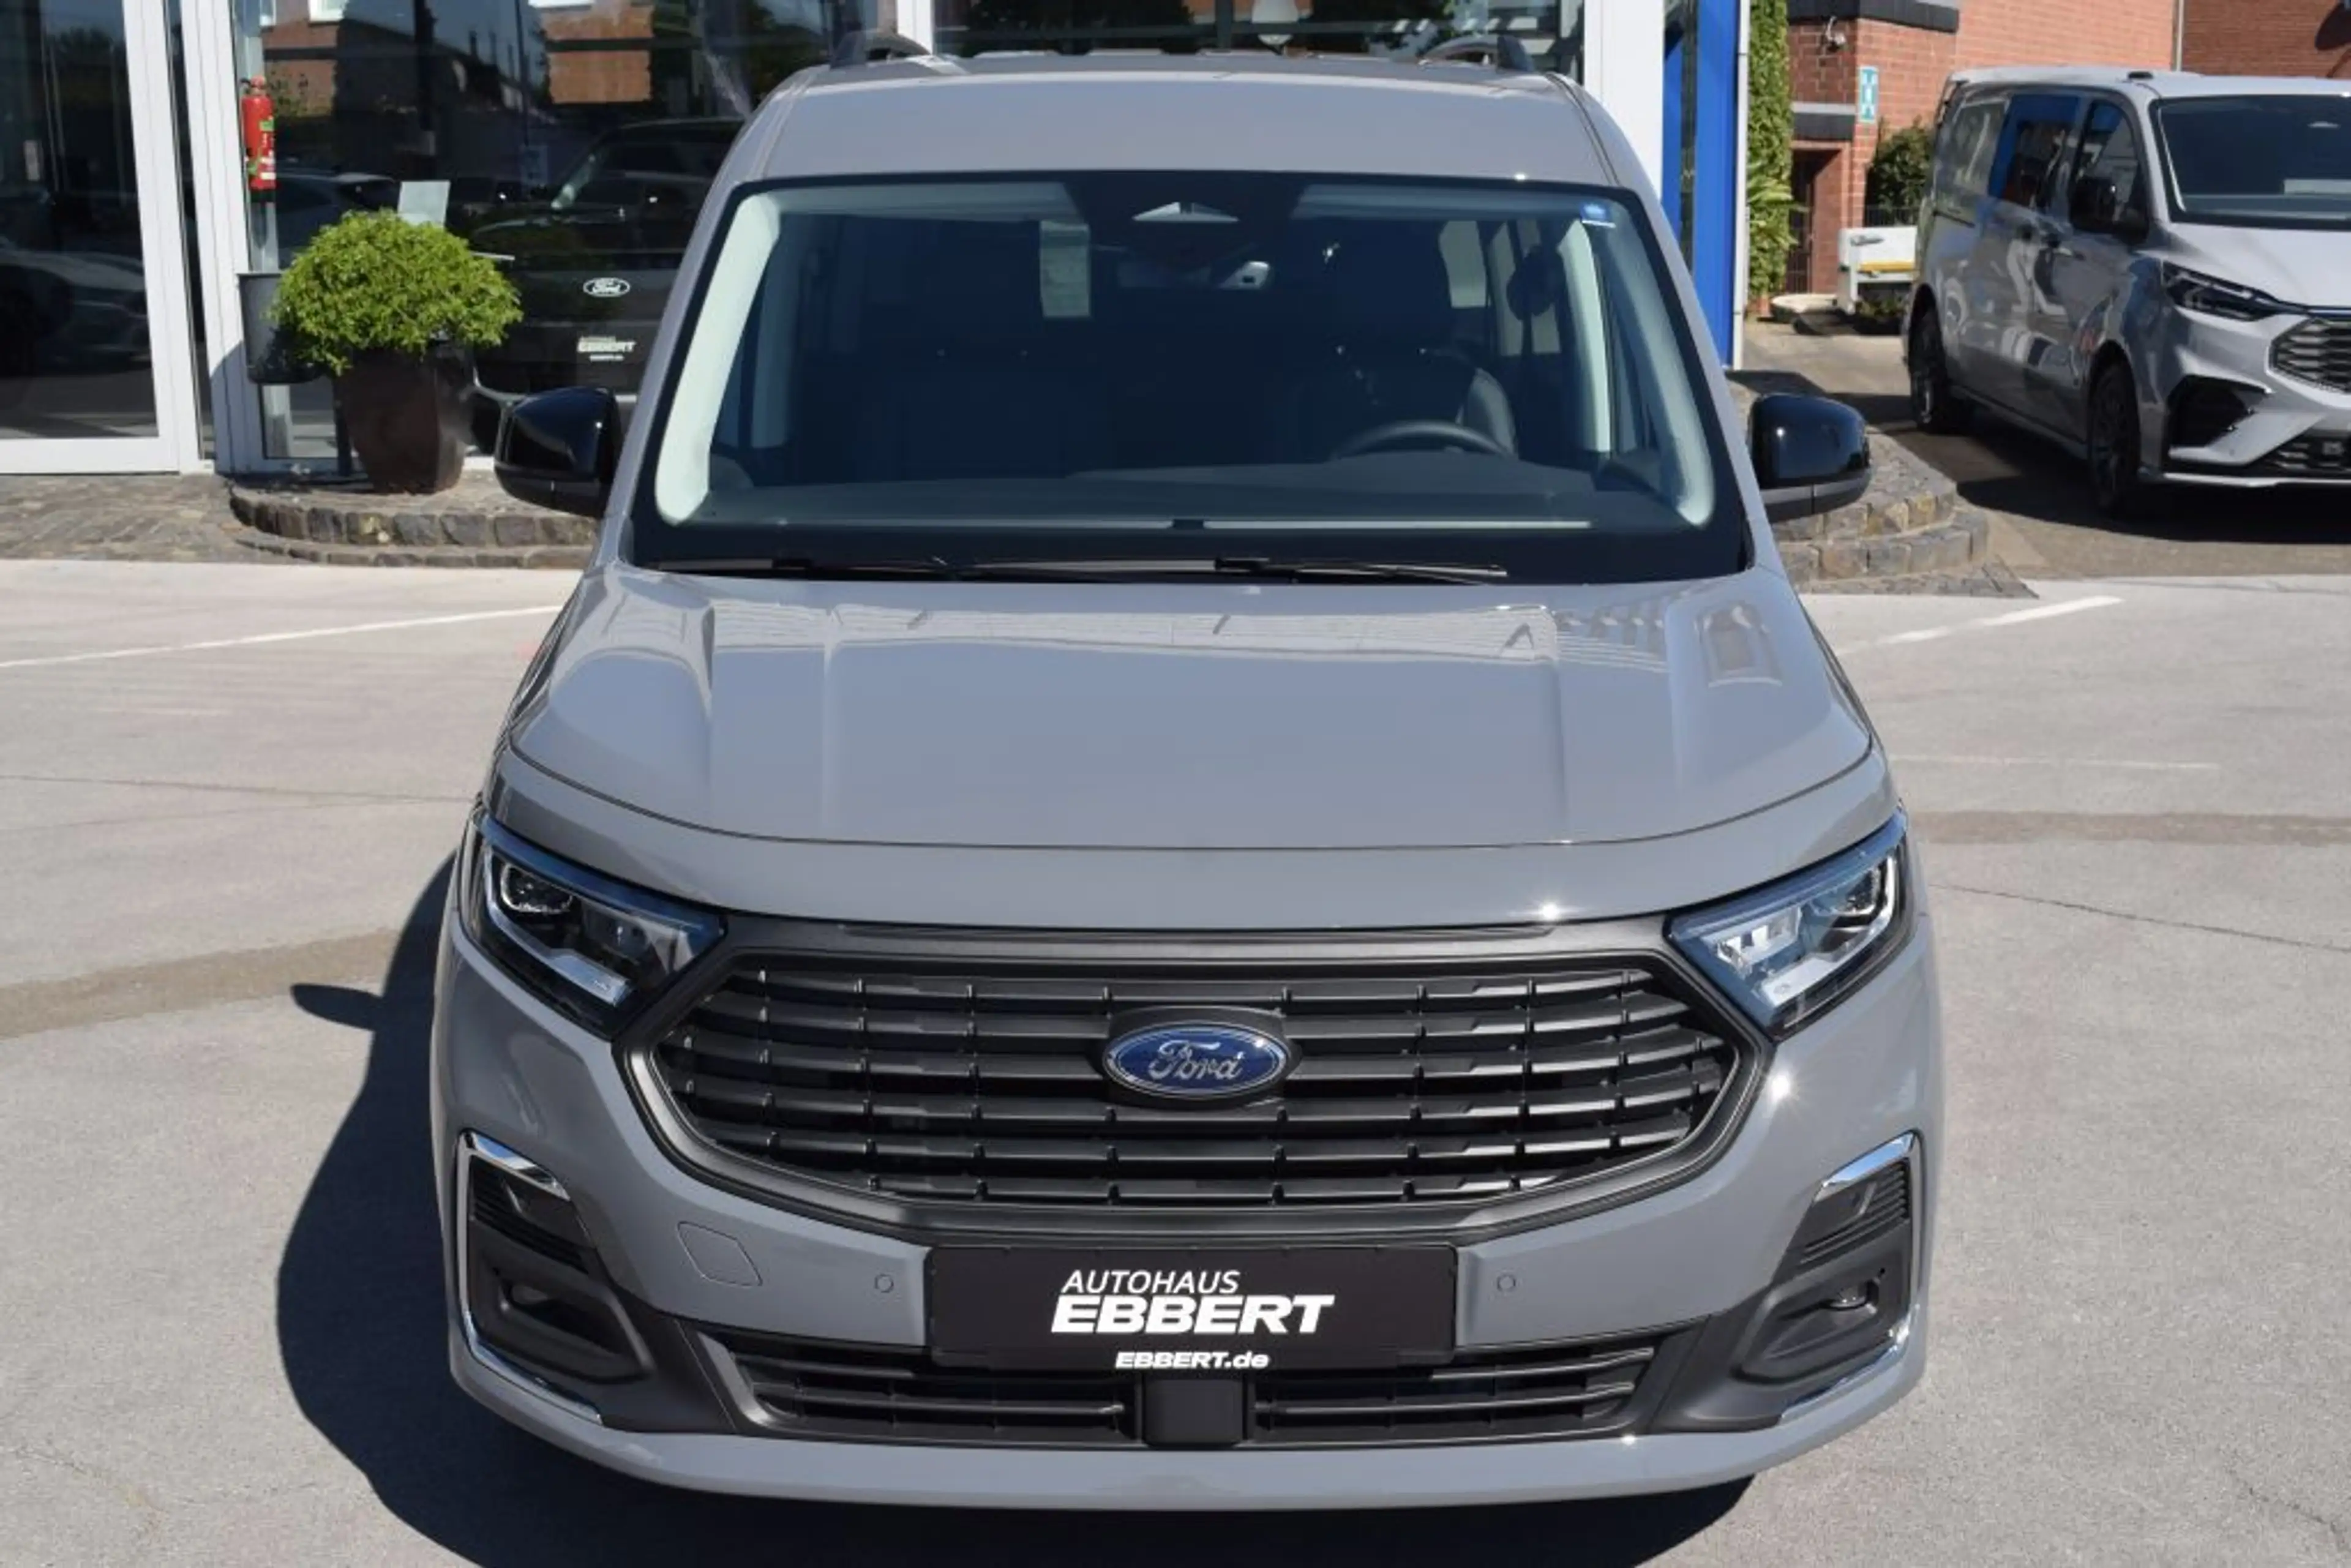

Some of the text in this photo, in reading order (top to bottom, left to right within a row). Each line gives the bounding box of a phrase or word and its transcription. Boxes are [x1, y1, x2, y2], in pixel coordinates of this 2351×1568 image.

[1148, 1040, 1245, 1080] Ford
[1060, 1270, 1240, 1294] AUTOHAUS
[1051, 1294, 1335, 1334] EBBERT
[1115, 1351, 1270, 1369] EBBERT.de
